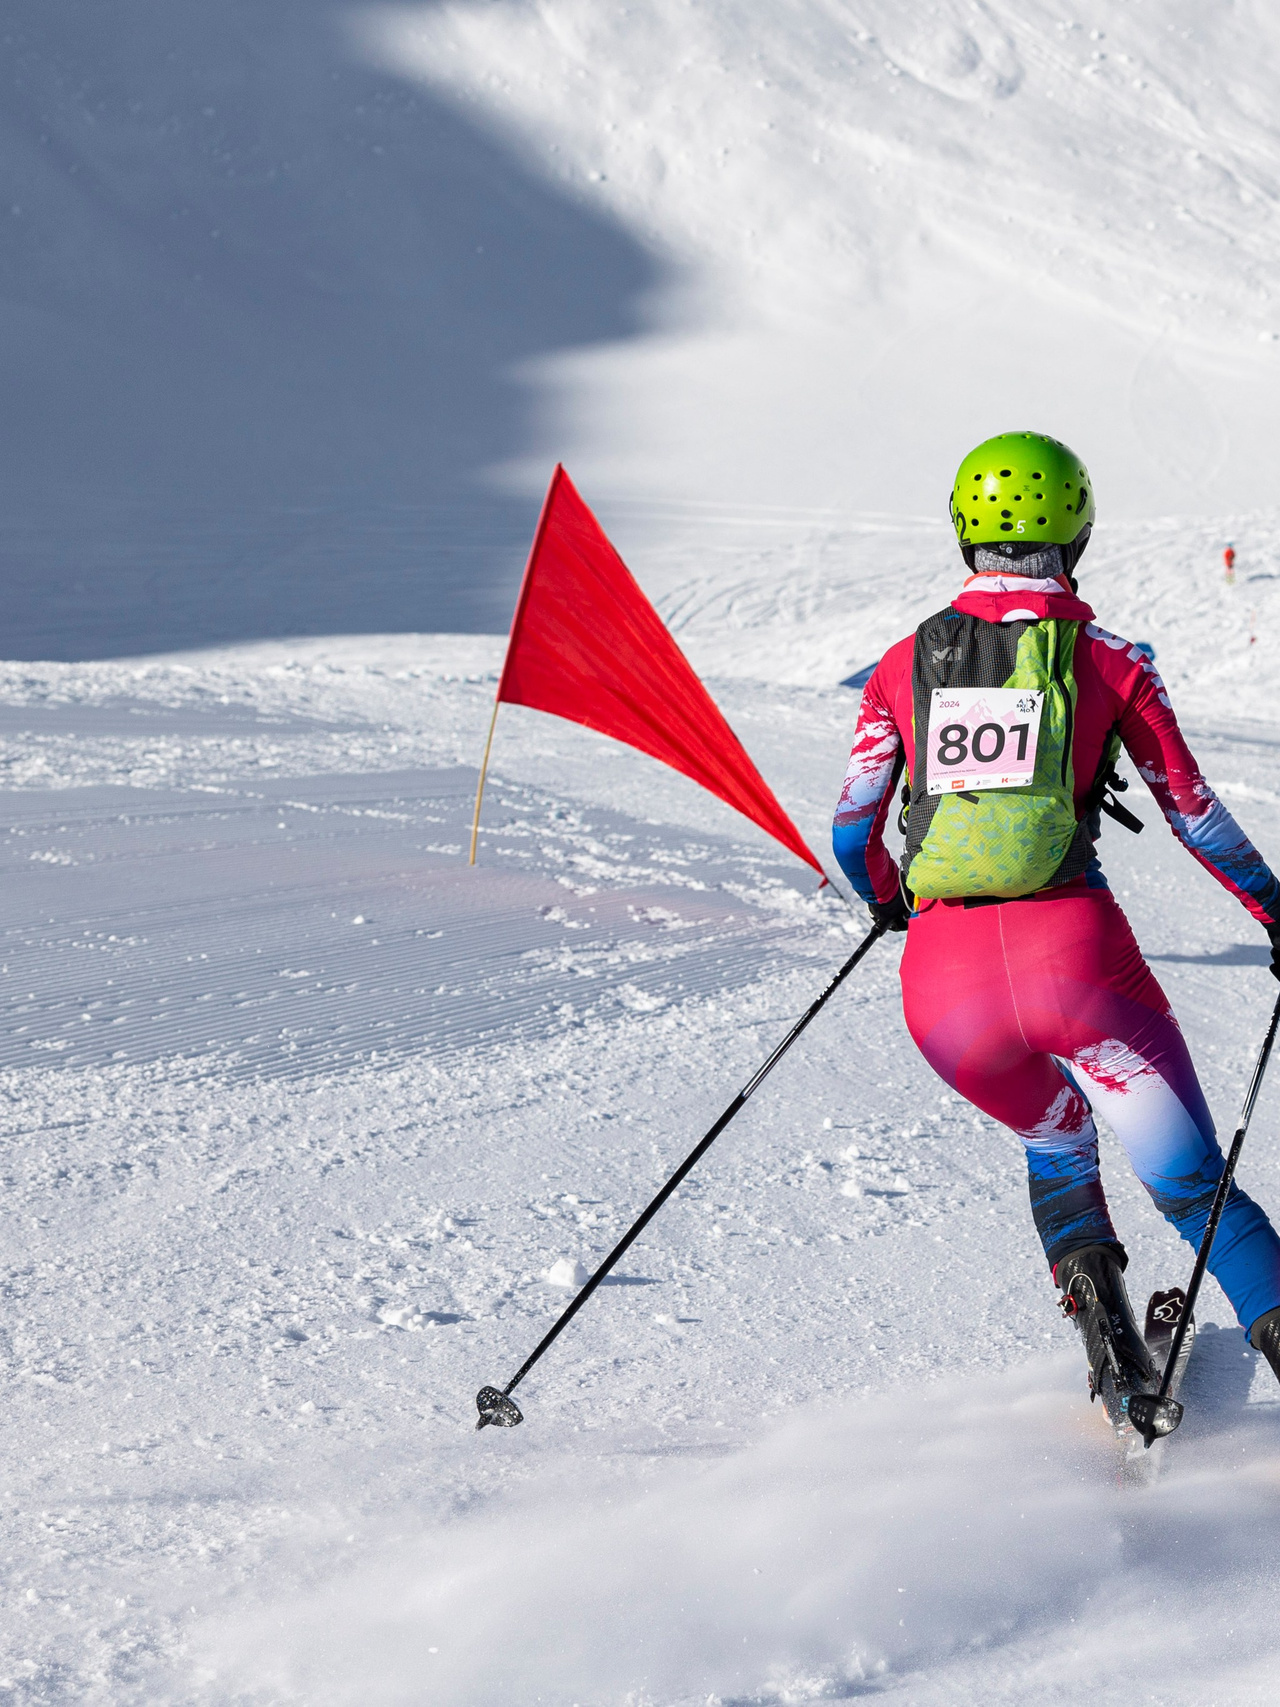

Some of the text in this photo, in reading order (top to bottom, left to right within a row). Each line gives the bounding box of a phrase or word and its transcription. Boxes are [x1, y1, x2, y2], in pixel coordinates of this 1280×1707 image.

[1016, 520, 1026, 534] 5
[939, 700, 960, 709] 2024
[937, 722, 1030, 766] 801
[1153, 1305, 1166, 1320] 5
